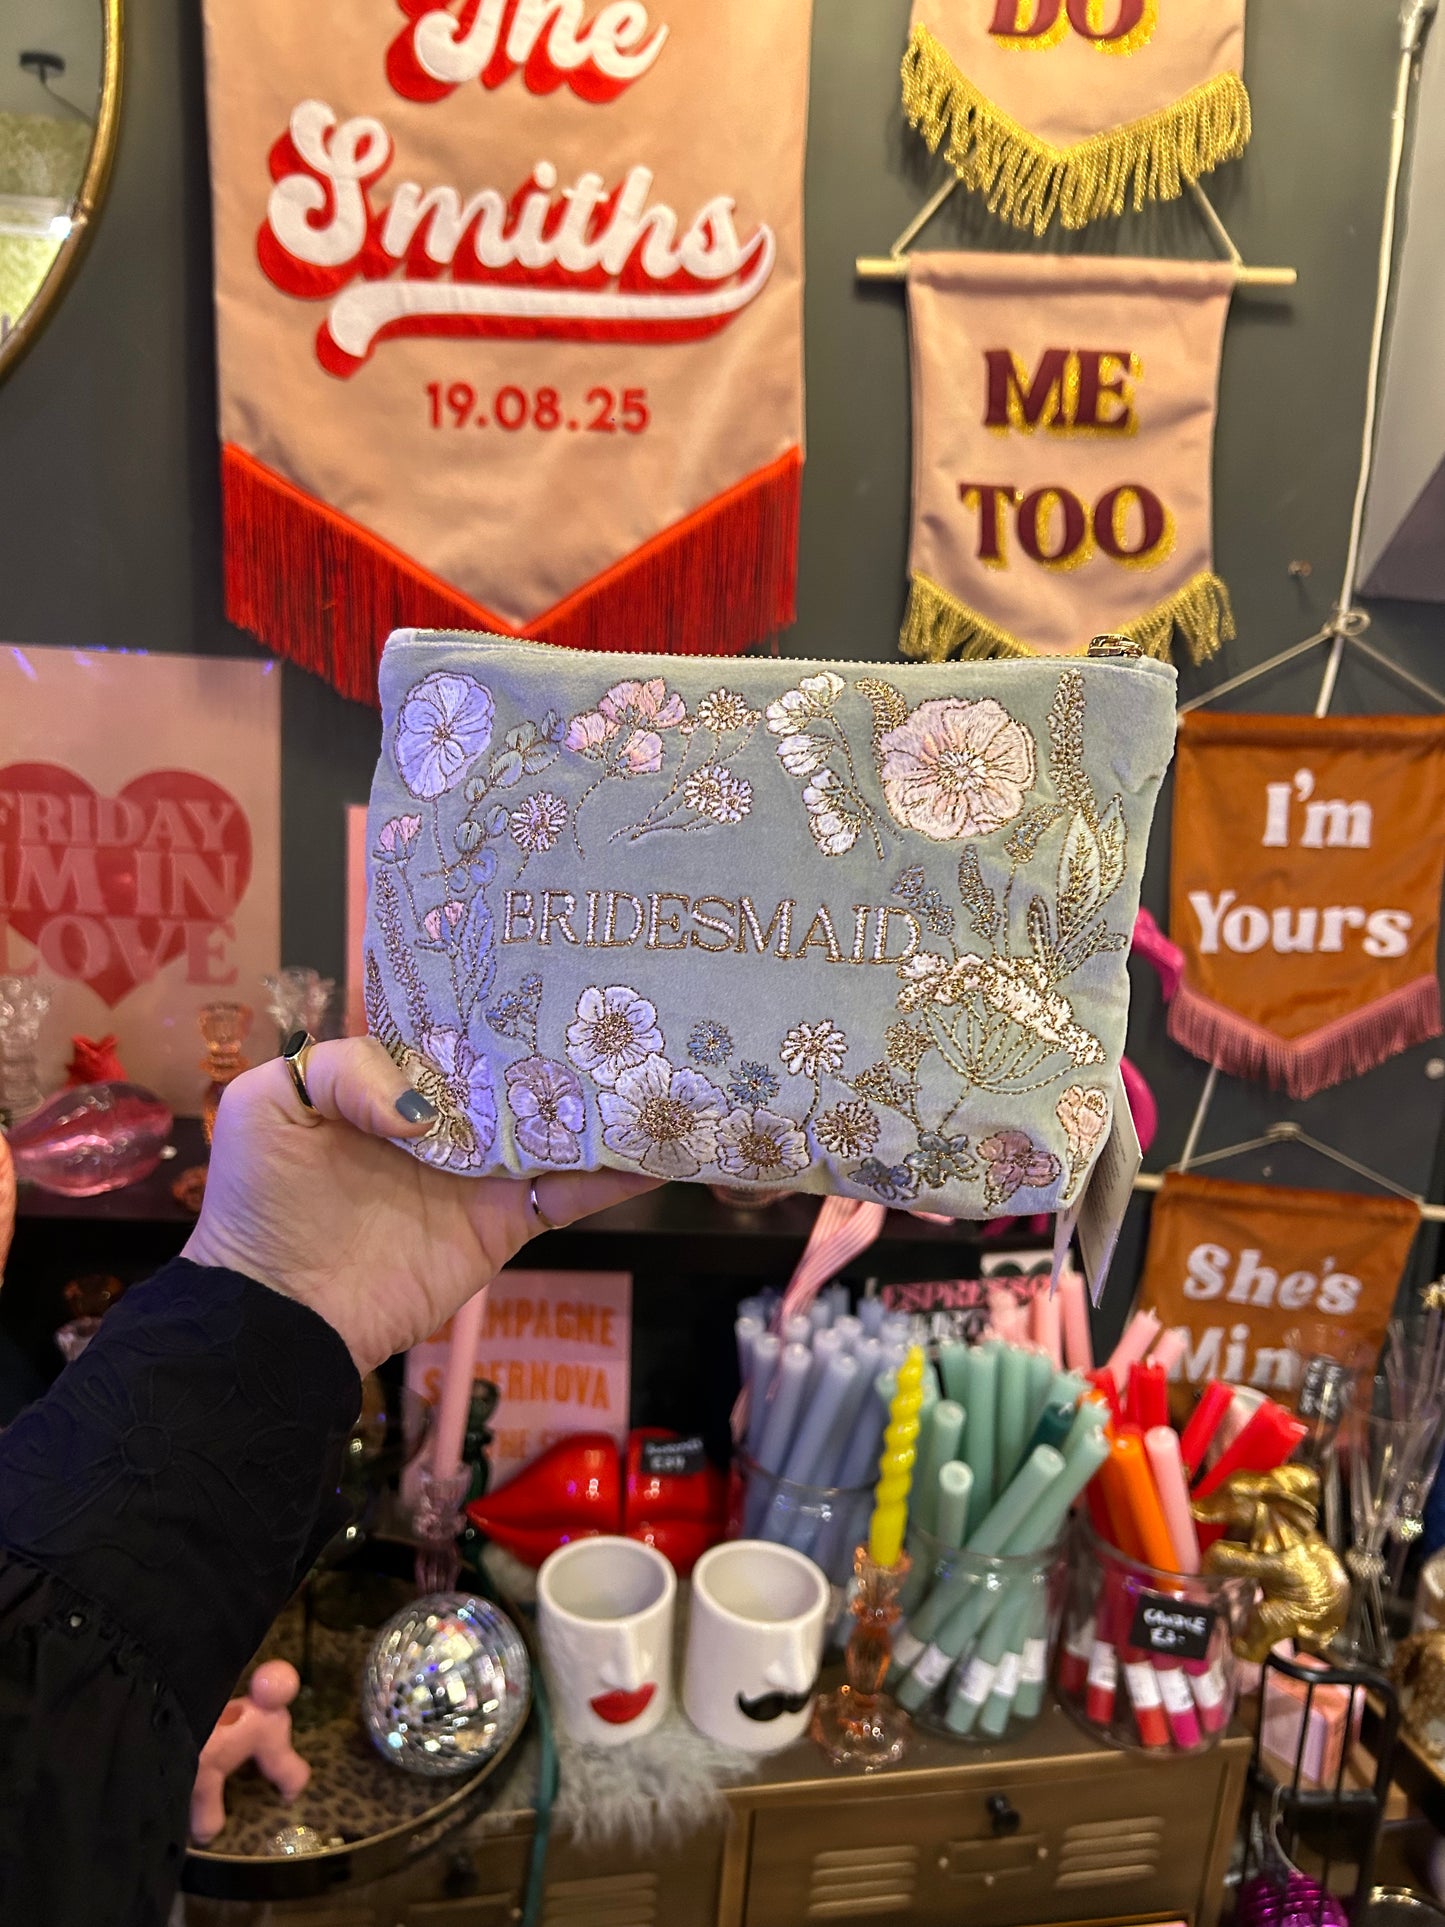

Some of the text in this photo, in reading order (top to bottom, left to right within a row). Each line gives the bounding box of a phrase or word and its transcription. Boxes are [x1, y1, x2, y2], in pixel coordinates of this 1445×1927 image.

[388, 0, 669, 102] The
[258, 100, 776, 360] Smiths
[427, 382, 650, 434] 19.08.25
[983, 348, 1143, 436] ME
[959, 483, 1176, 571] TOO
[1262, 768, 1372, 850] I'm
[133, 850, 239, 917] IN
[501, 889, 922, 965] BRIDESMAID
[1188, 889, 1413, 958] Yours
[1183, 1242, 1363, 1315] She's
[427, 1297, 616, 1347] MPAGNE
[1167, 1323, 1303, 1390] Min
[422, 1360, 612, 1412] SERNOVA
